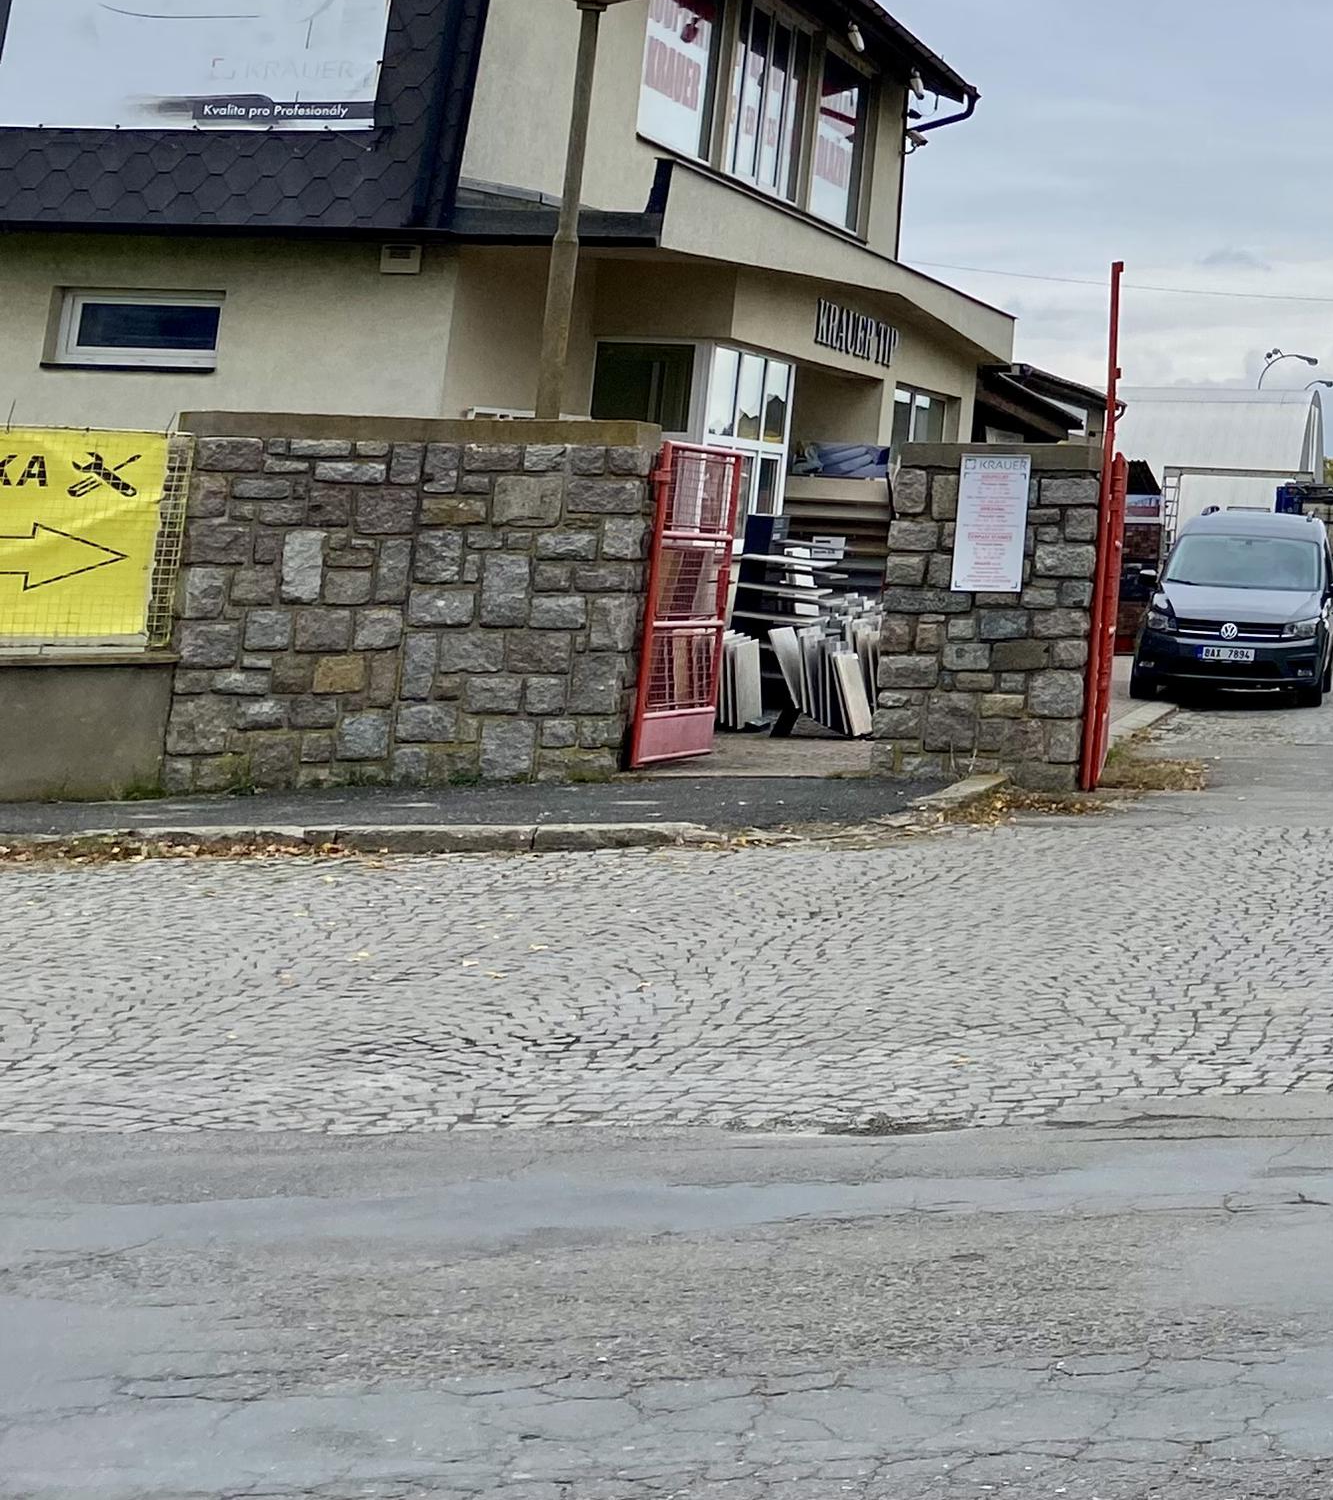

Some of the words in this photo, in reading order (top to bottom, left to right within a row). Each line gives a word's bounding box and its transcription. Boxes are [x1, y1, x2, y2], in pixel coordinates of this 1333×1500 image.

[203, 104, 245, 116] Kvalita
[249, 108, 271, 118] pro
[273, 104, 348, 118] Profesionály
[979, 460, 1028, 470] KRAUER
